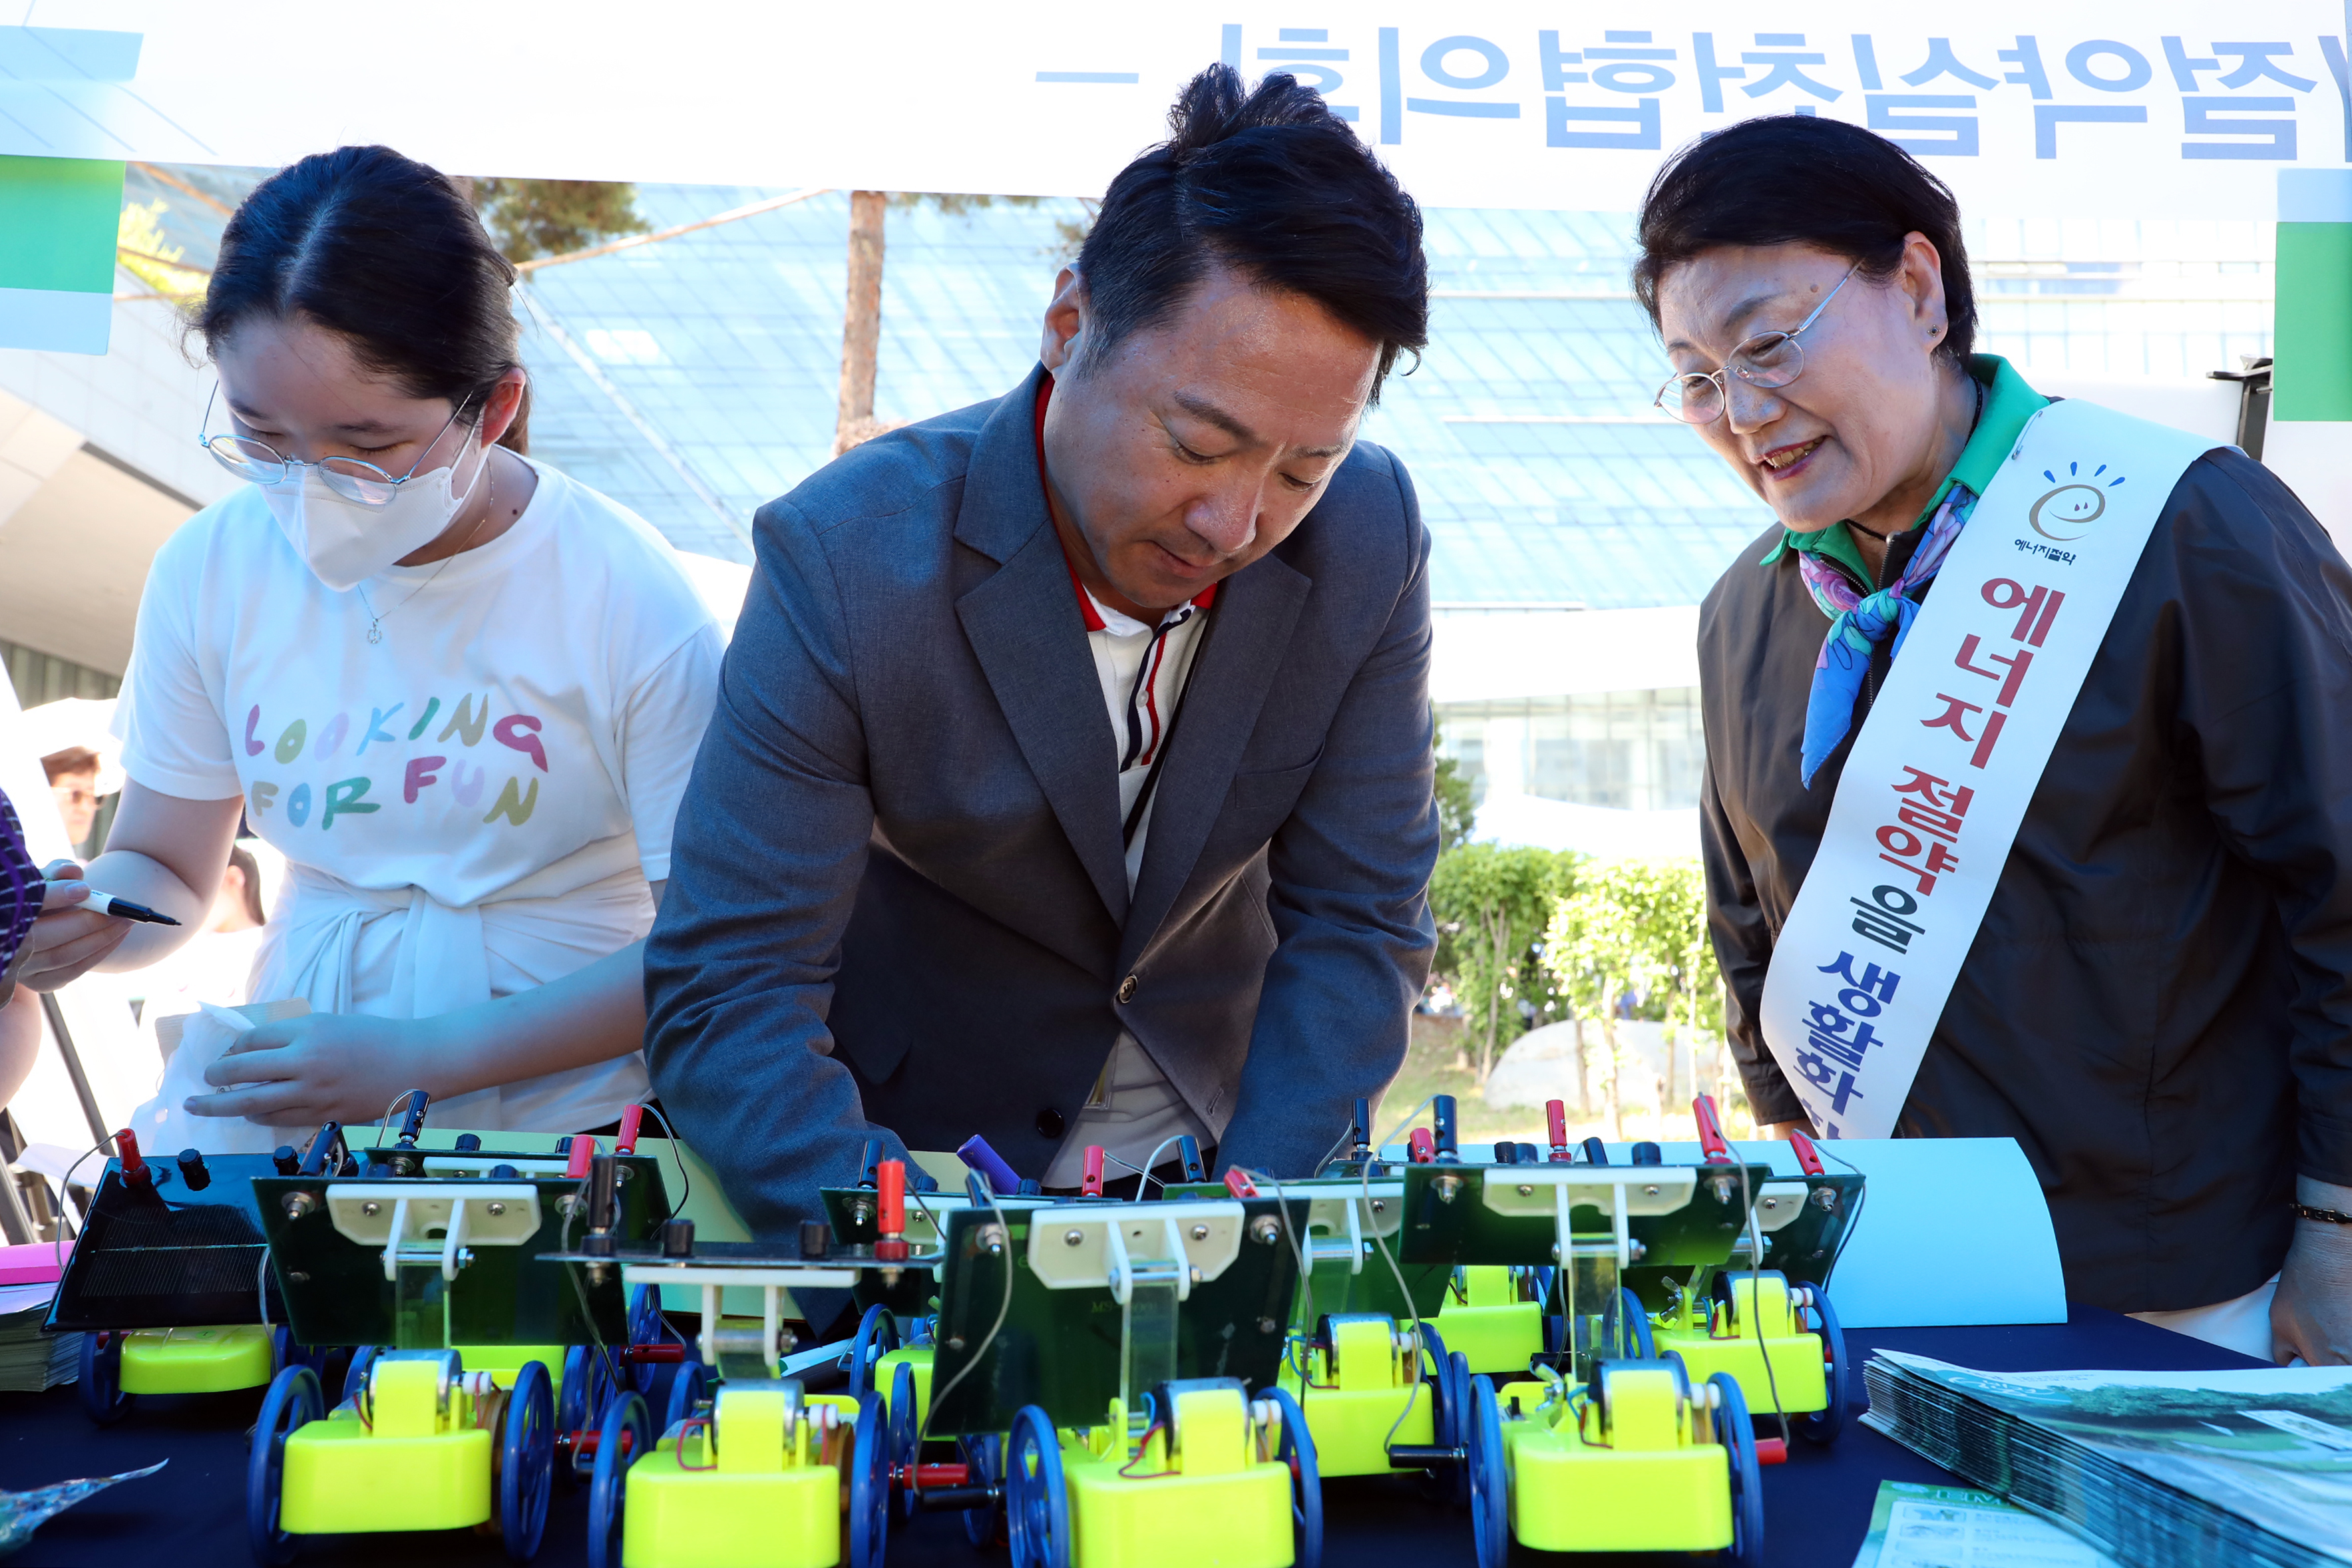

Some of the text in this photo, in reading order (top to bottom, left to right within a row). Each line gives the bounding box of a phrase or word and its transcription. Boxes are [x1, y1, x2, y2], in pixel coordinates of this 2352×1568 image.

[2014, 538, 2077, 566] 에너지절약
[1920, 576, 2066, 769] 에너지
[245, 692, 549, 773] LOOKING
[250, 755, 539, 831] FOR FUN
[1850, 765, 1975, 954] 절약을
